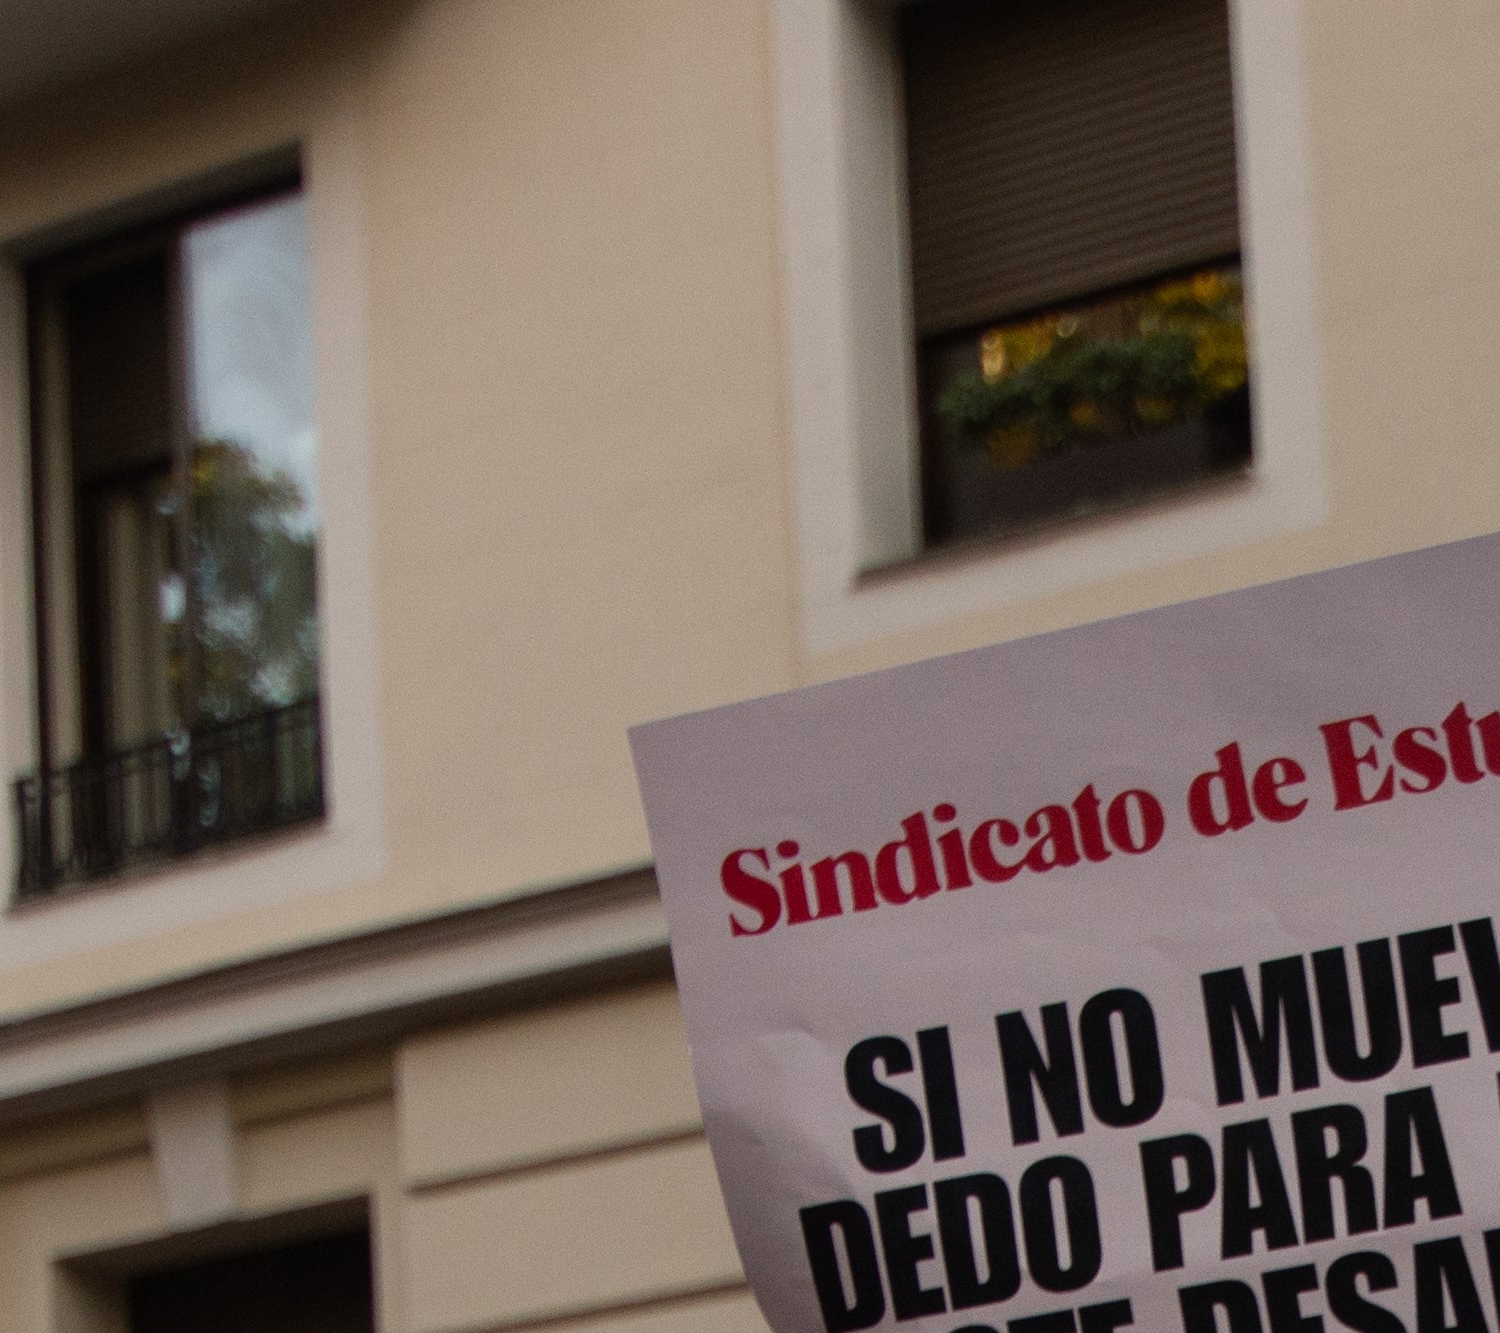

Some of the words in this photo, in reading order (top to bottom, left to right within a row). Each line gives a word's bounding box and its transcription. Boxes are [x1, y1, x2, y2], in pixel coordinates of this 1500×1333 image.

[720, 802, 1165, 938] Sindicato
[1187, 742, 1308, 837] de
[844, 1025, 965, 1173] SI
[995, 987, 1165, 1145] NO
[1139, 1085, 1462, 1272] PARA
